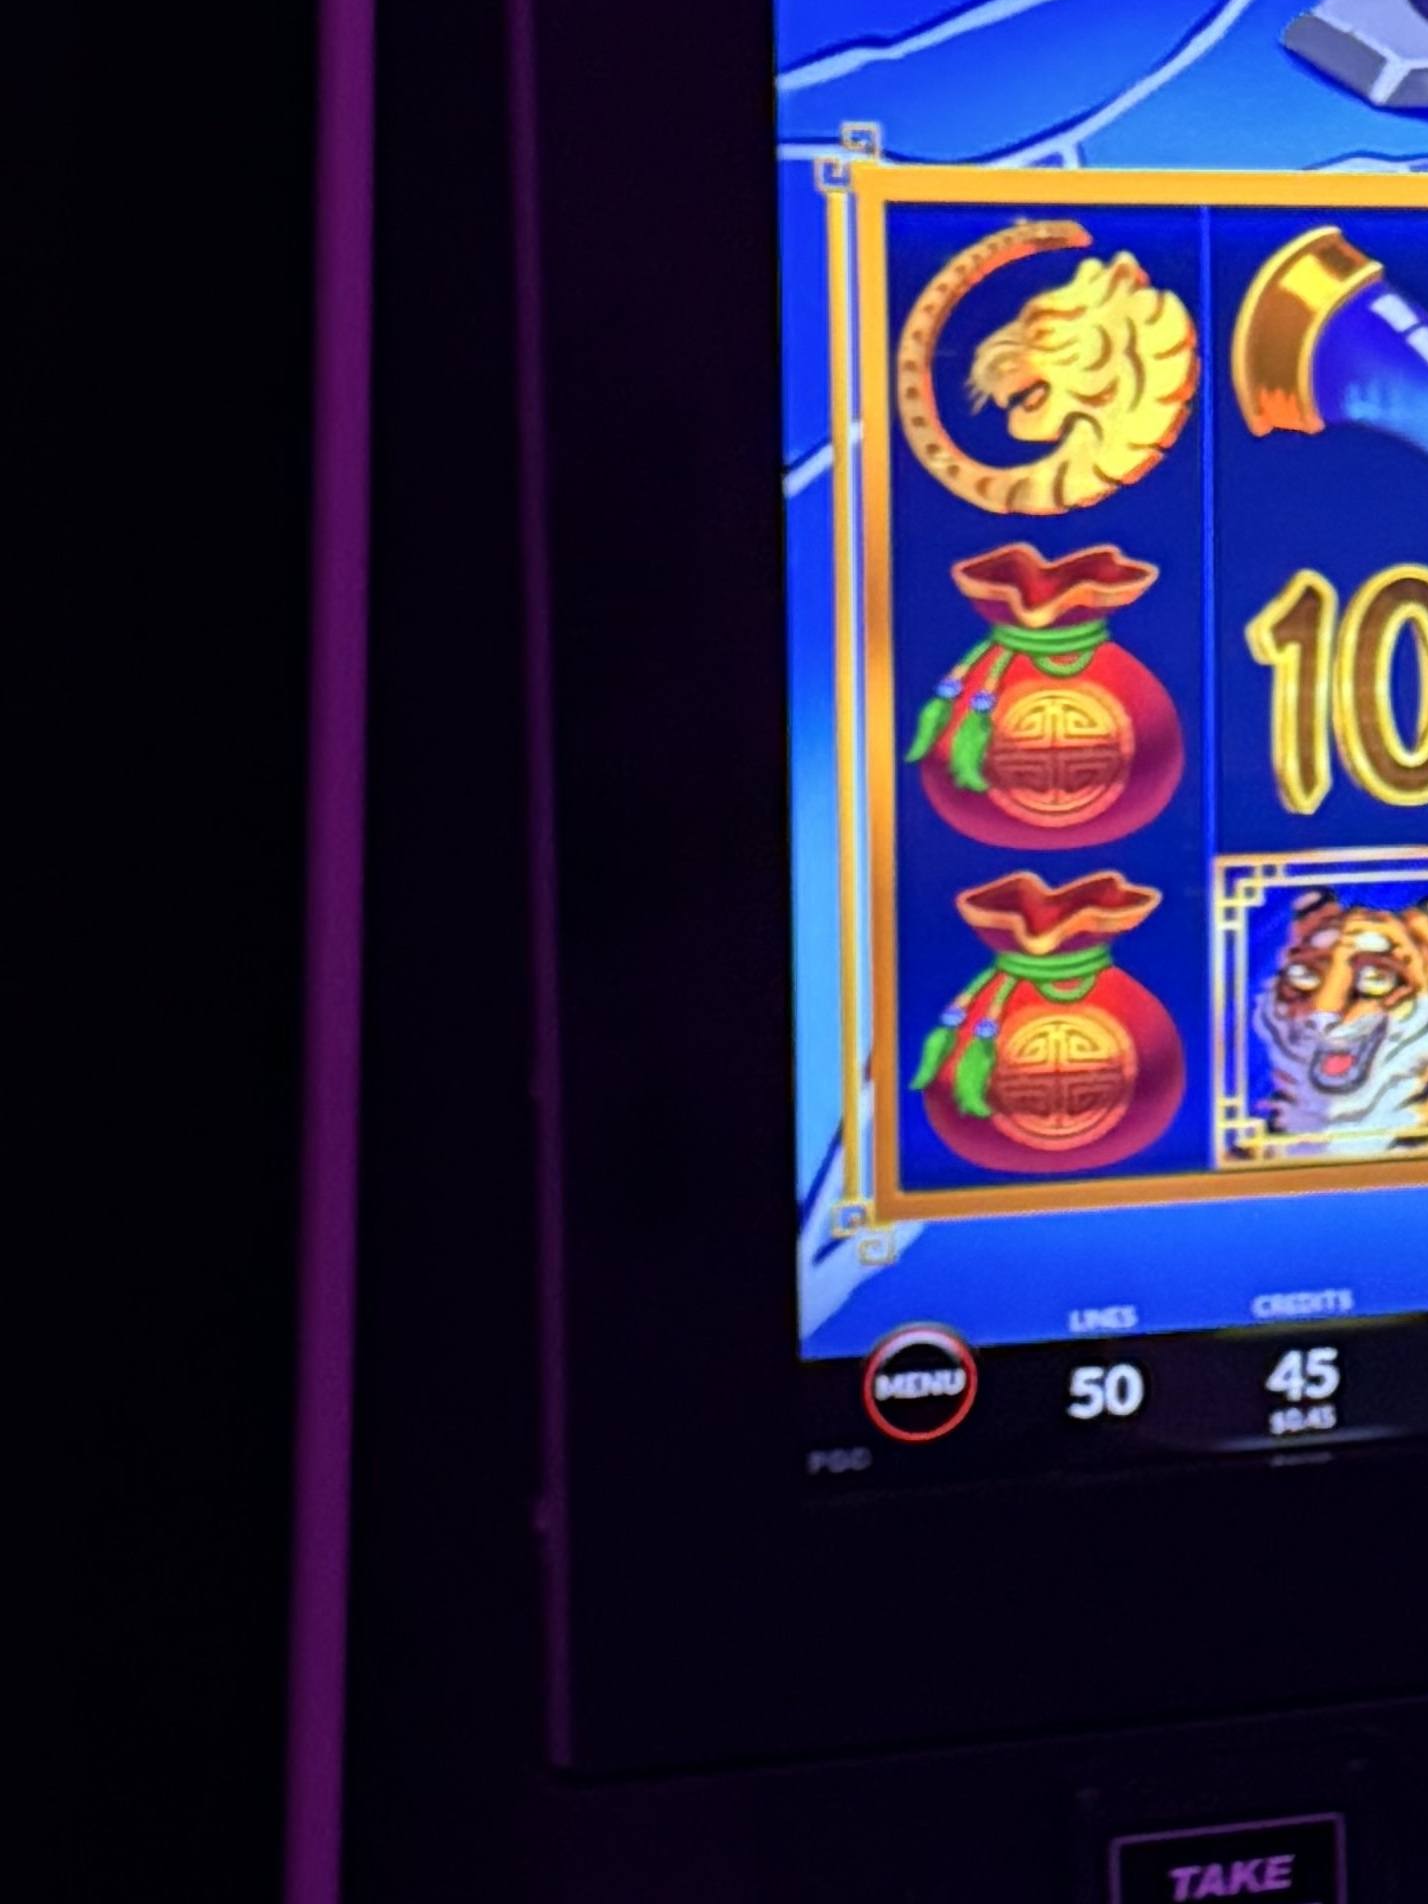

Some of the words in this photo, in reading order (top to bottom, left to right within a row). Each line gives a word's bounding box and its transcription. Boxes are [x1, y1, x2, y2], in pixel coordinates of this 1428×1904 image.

[1067, 1304, 1138, 1333] LINES
[1252, 1288, 1355, 1320] CREDITS
[875, 1366, 967, 1401] MENU
[1066, 1362, 1145, 1421] 50
[1264, 1346, 1341, 1403] 45
[1168, 1853, 1297, 1903] TAKE
